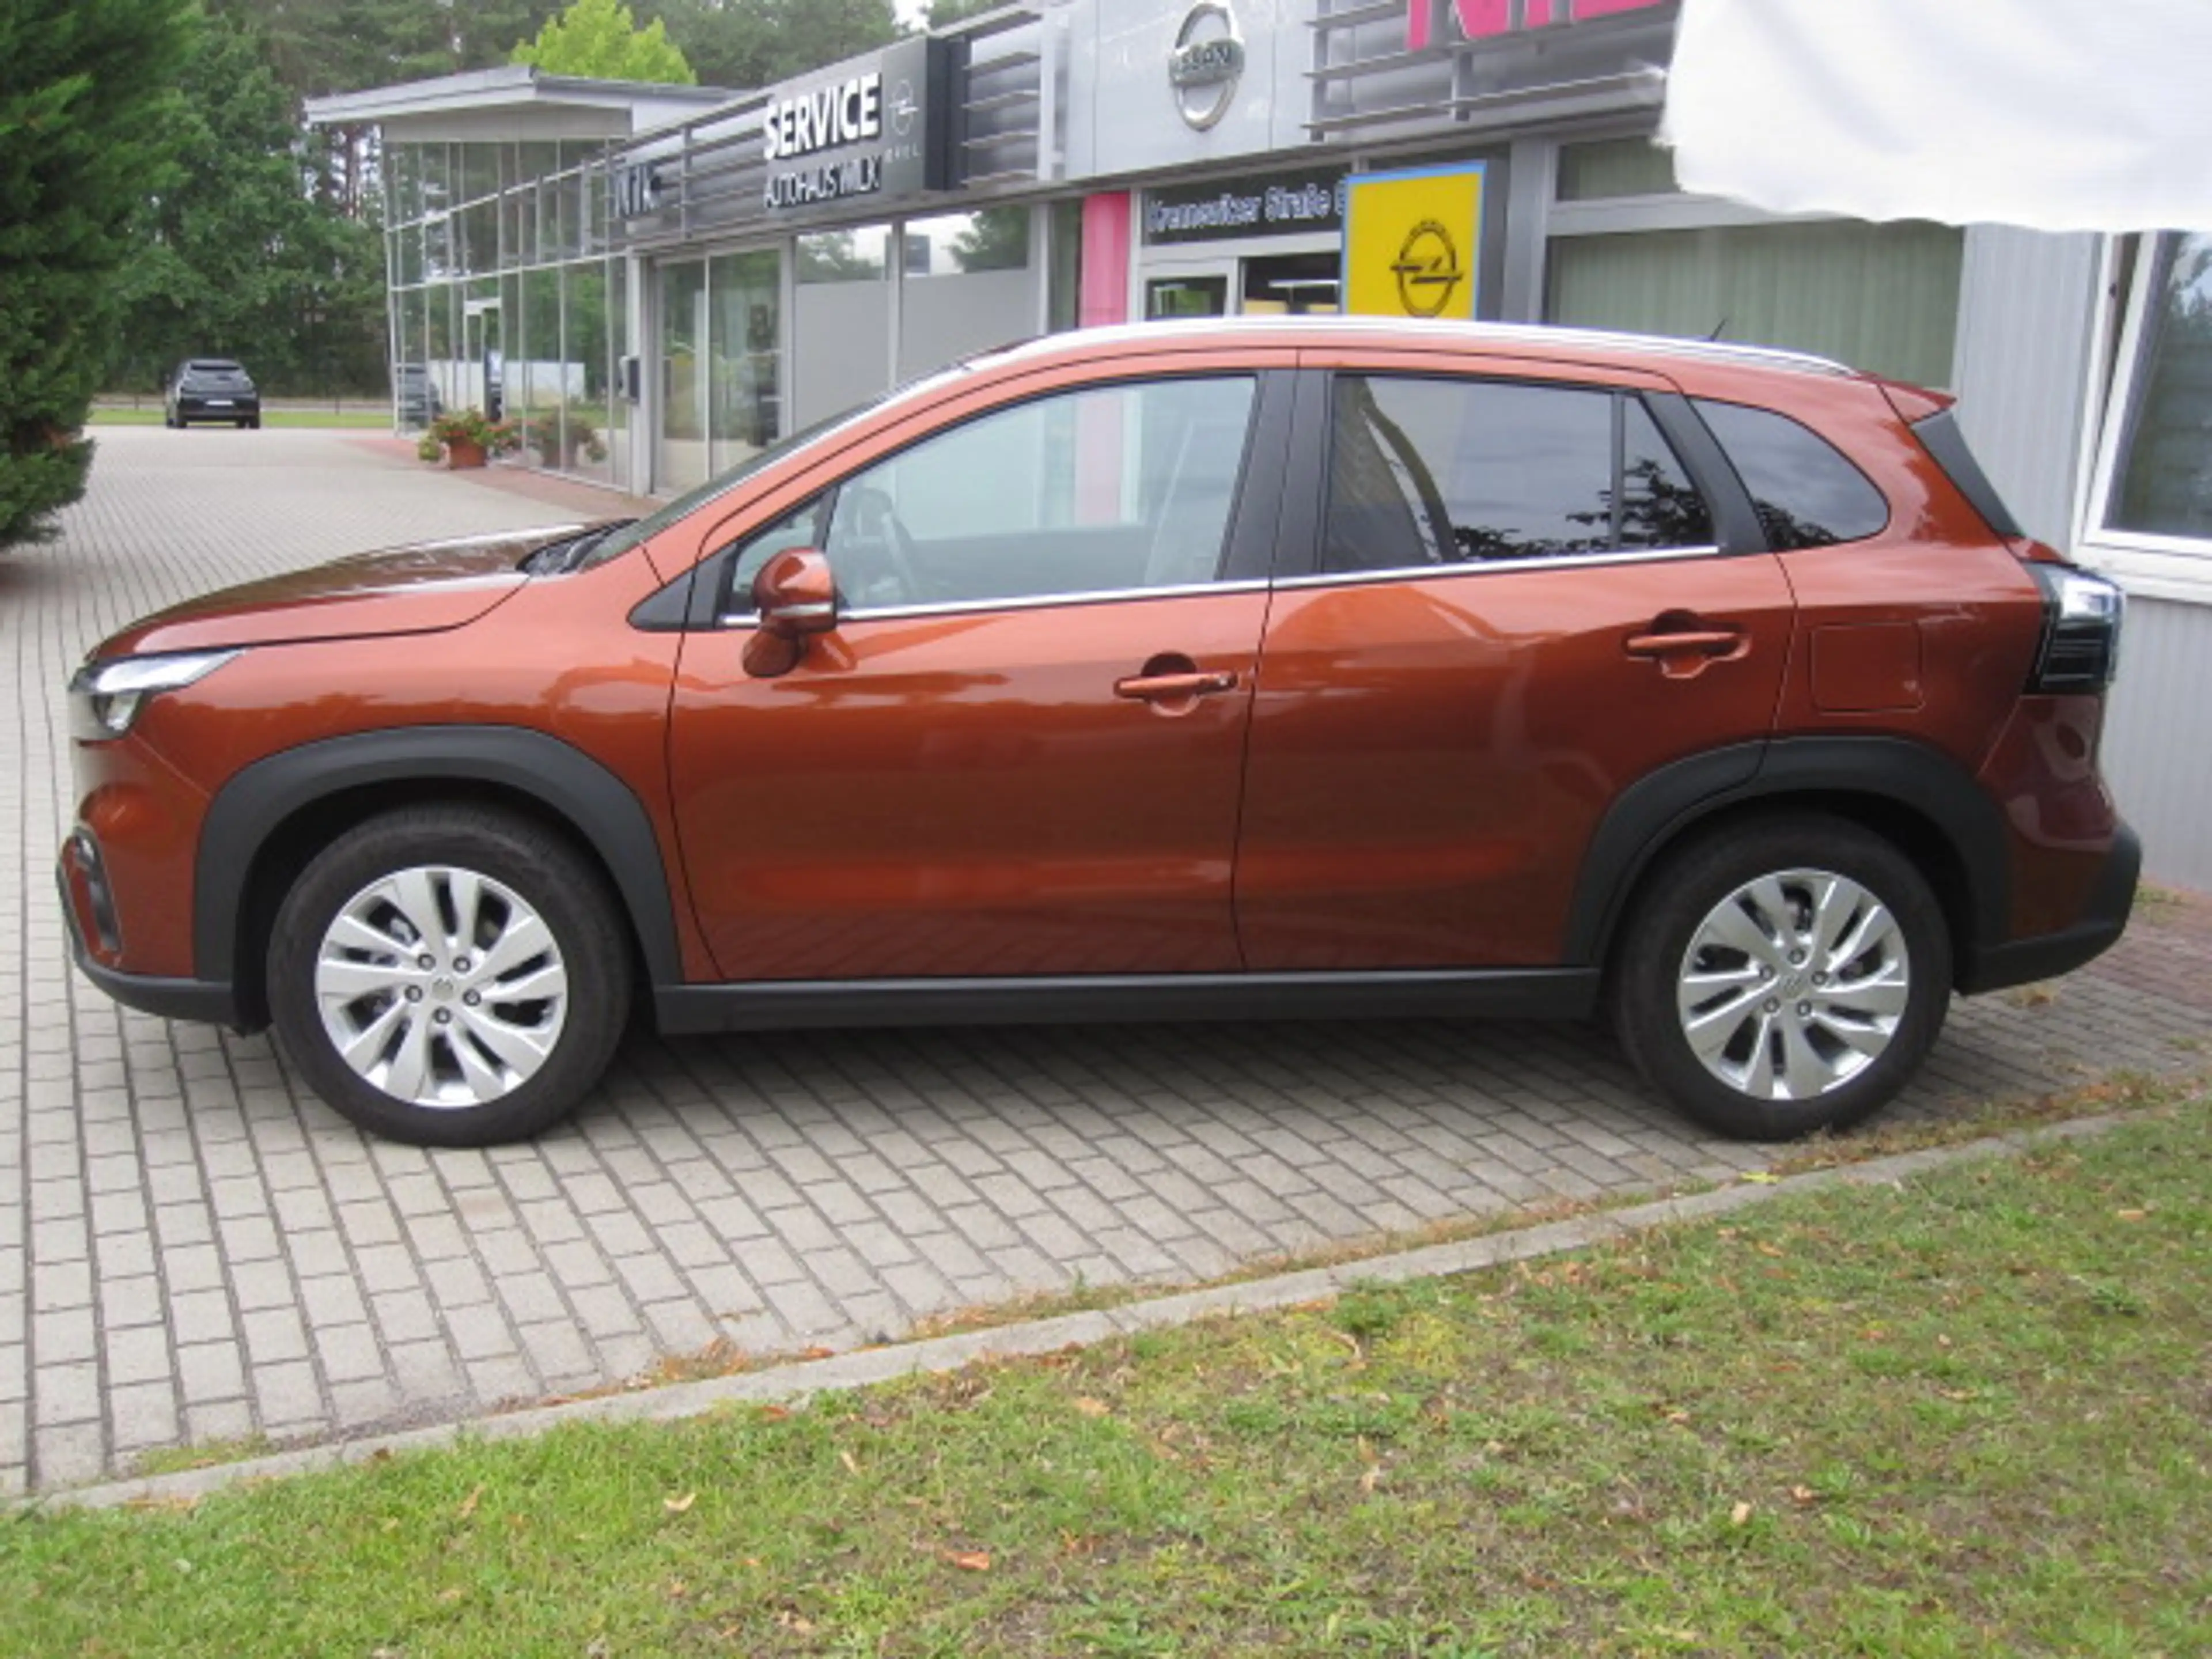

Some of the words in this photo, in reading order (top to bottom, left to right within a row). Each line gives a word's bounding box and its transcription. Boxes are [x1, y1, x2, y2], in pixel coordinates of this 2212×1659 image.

[763, 72, 880, 160] SERVICE
[763, 162, 838, 208] AUTOHAUS
[1265, 183, 1331, 222] Straße
